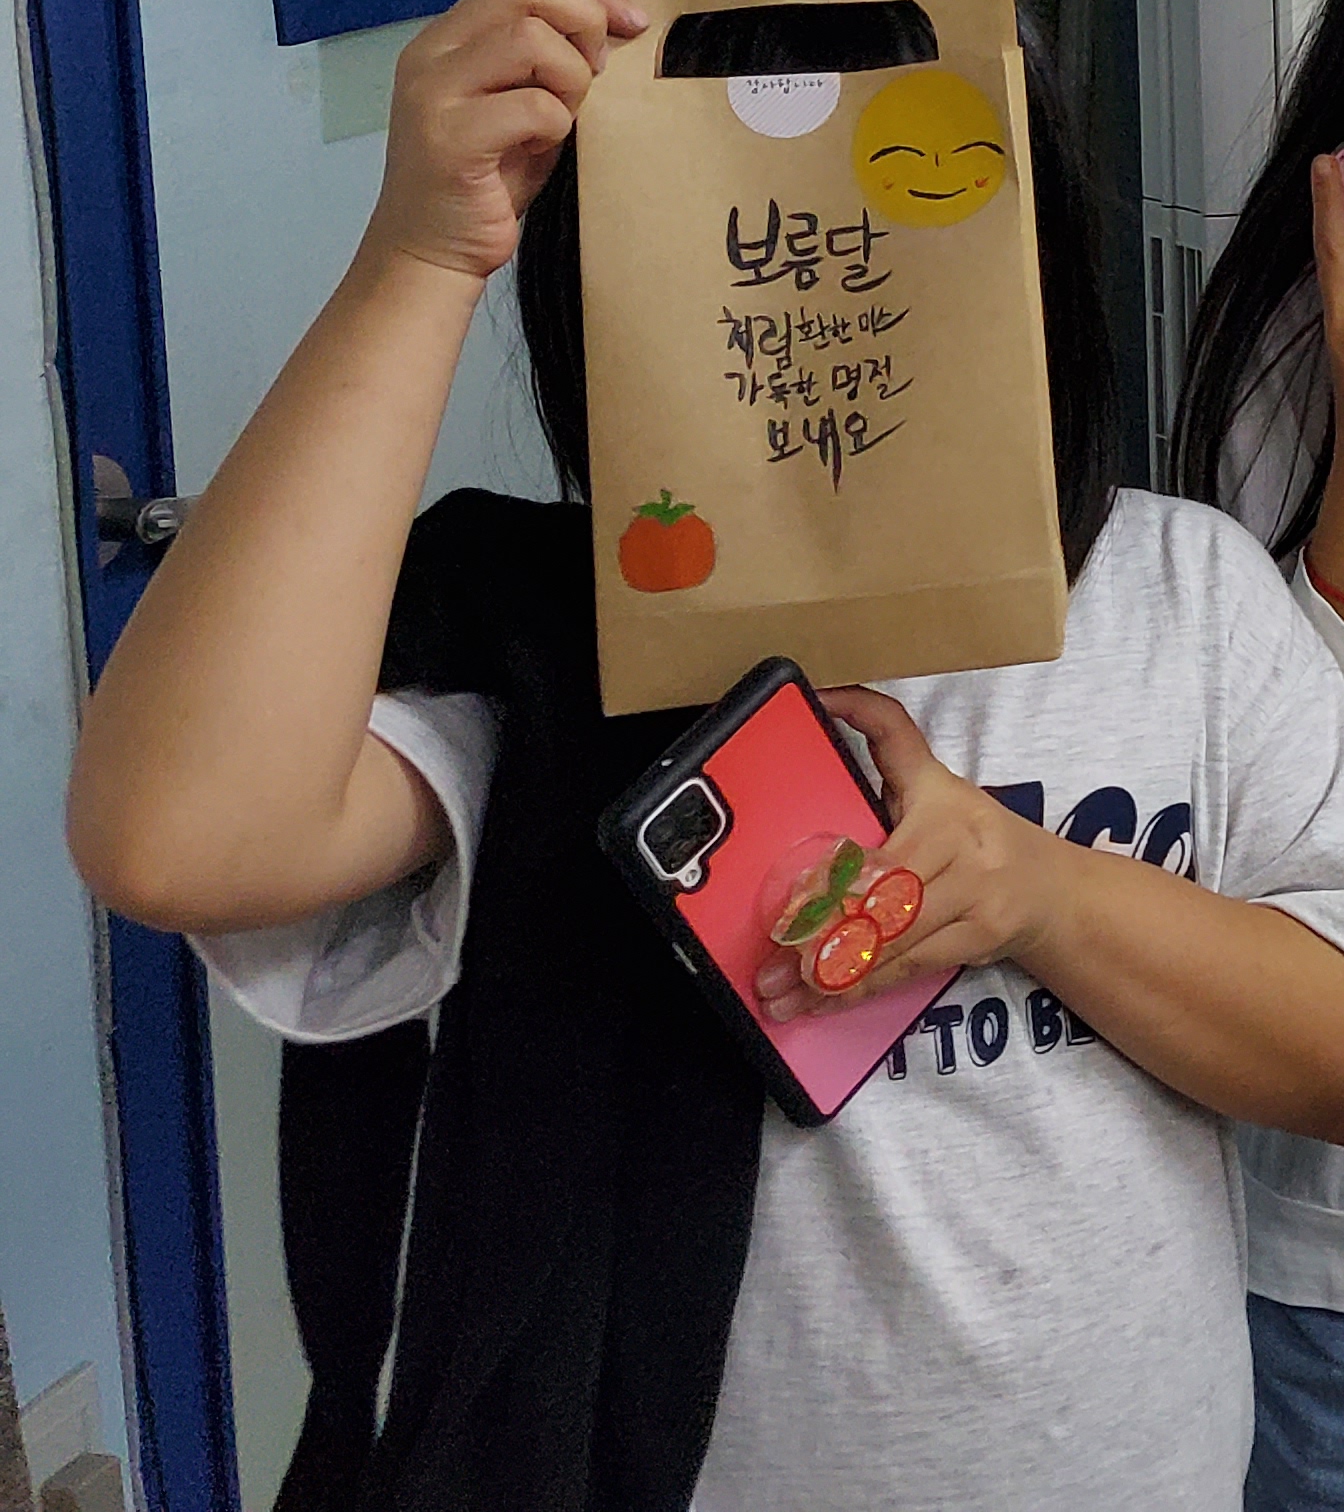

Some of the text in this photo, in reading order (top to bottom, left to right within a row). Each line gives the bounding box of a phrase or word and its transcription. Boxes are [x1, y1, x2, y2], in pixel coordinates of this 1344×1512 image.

[726, 198, 892, 293] 보름달
[724, 355, 915, 409] 가득한 명절
[767, 408, 907, 494] 보내요
